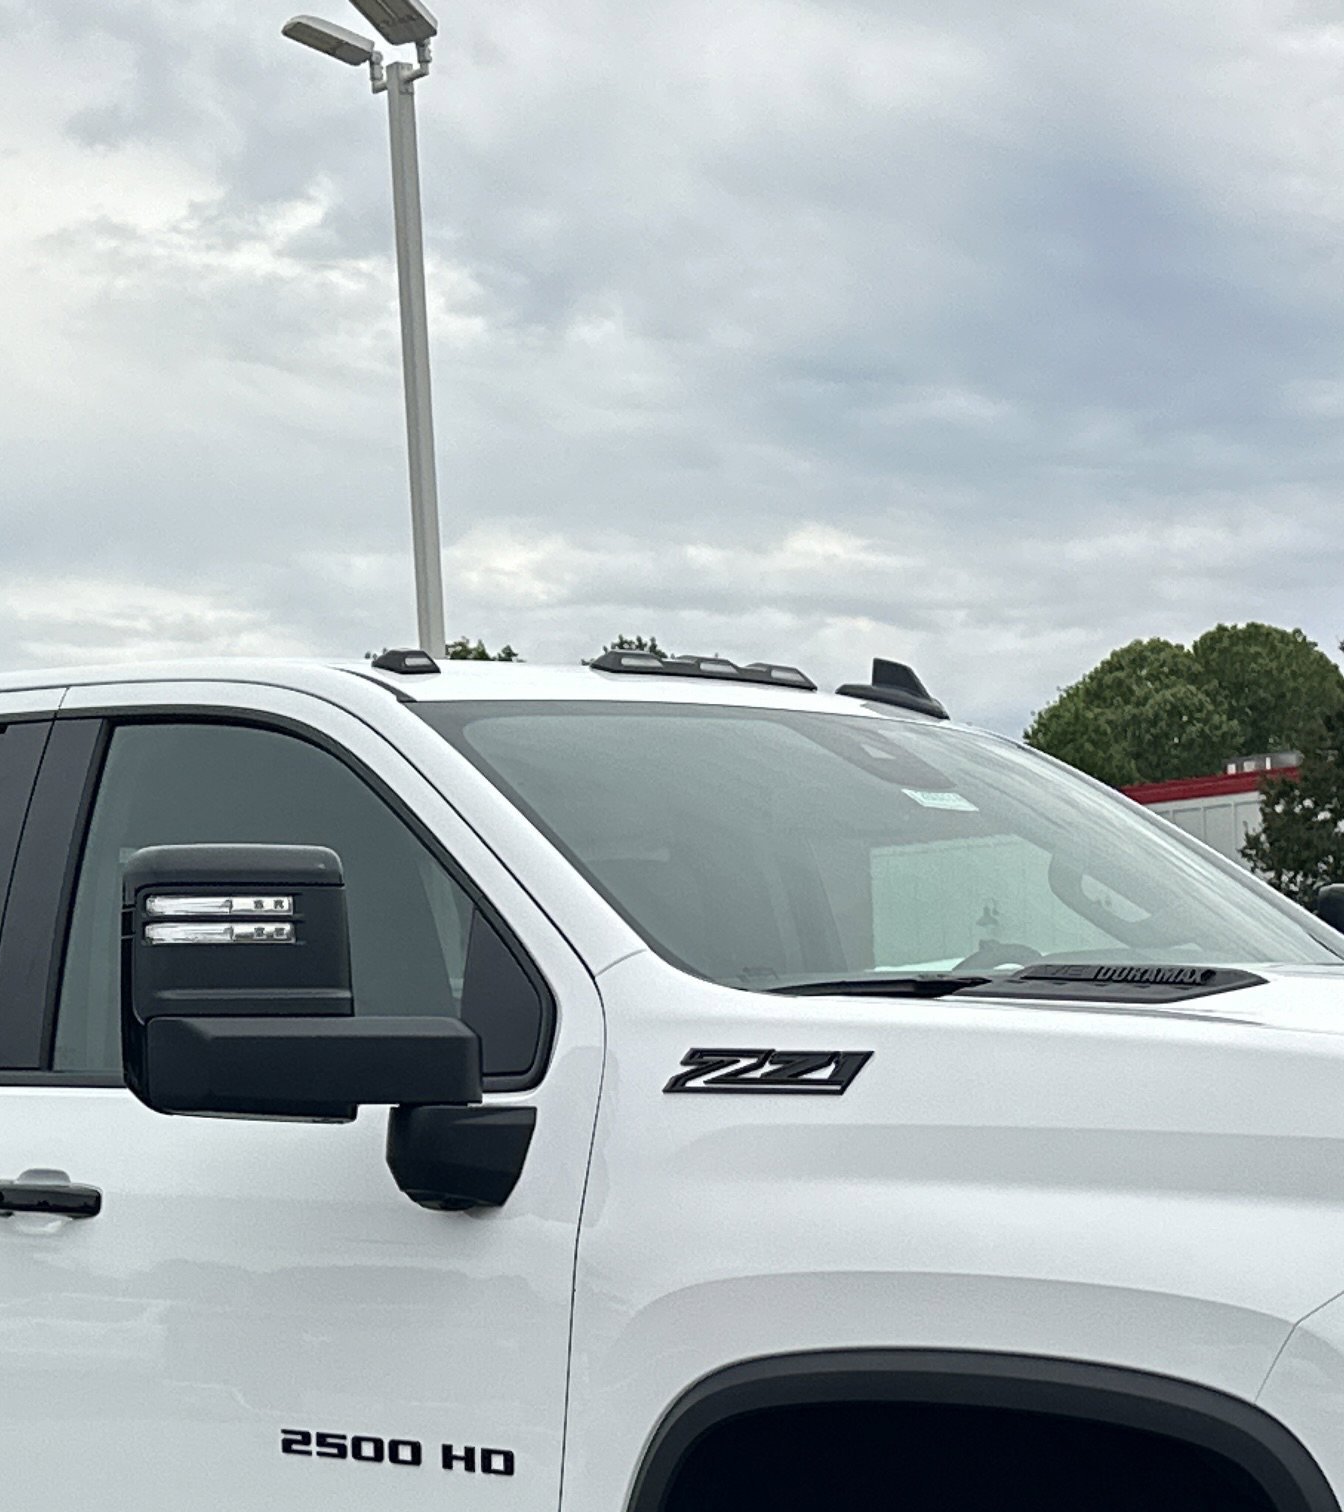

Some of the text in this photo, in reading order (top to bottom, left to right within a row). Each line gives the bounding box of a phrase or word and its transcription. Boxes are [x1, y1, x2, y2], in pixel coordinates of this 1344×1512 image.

[1094, 965, 1208, 984] DURAMAX
[662, 1047, 874, 1095] Z71
[280, 1428, 515, 1477] 2500 HD
